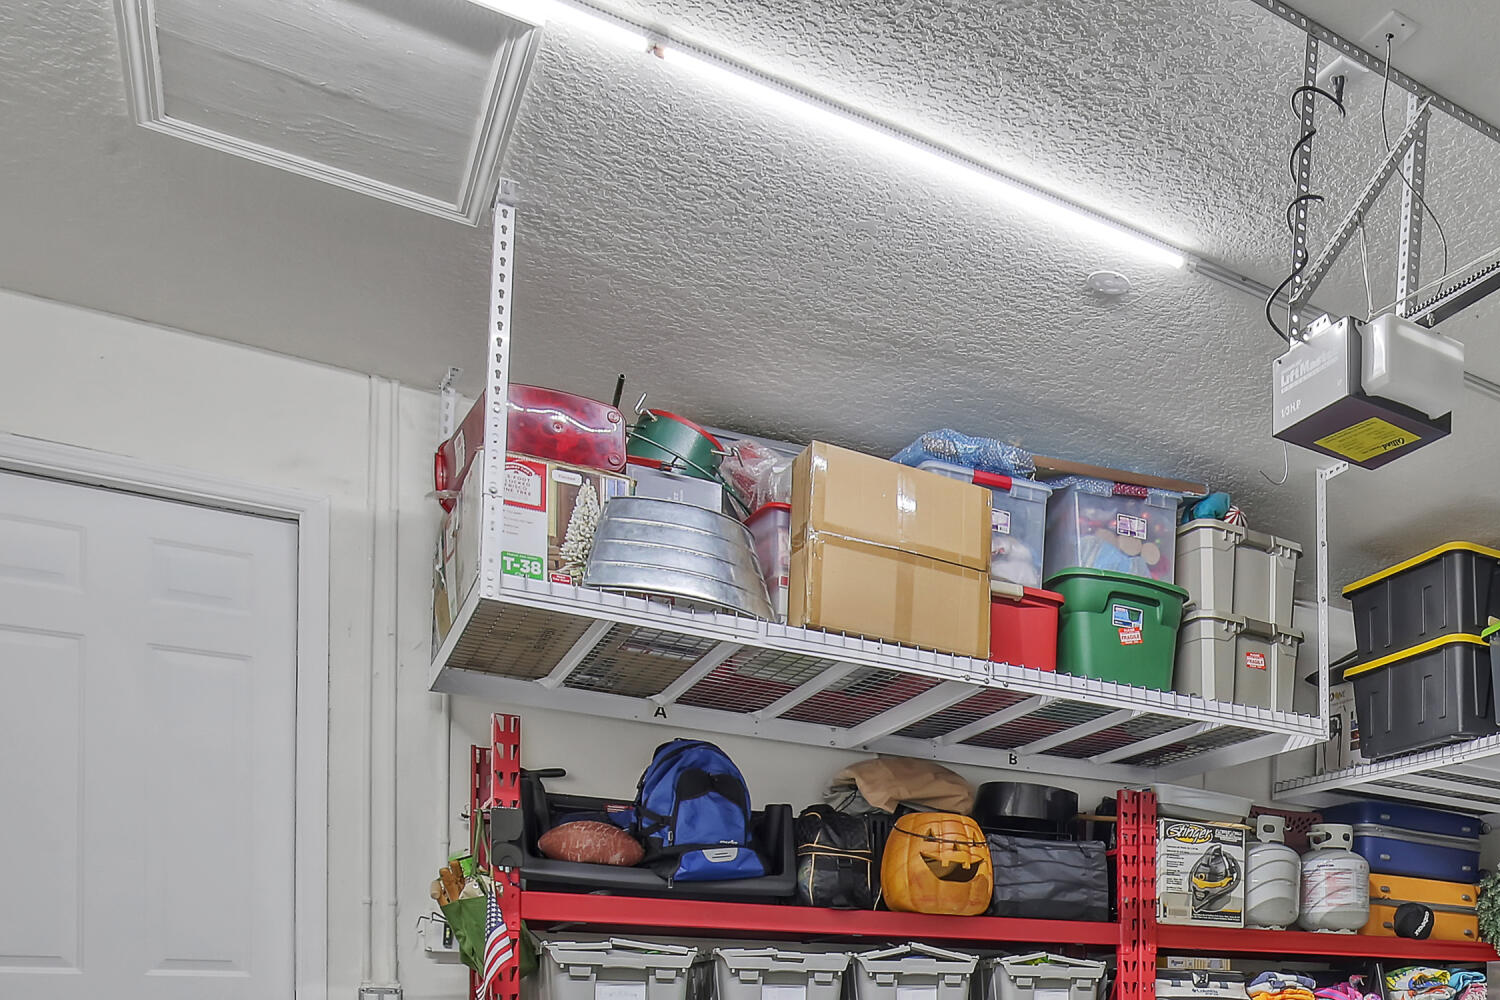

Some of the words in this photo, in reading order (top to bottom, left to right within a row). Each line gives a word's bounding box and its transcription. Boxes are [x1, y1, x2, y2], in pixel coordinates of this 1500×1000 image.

[503, 556, 542, 576] T-38
[653, 705, 668, 719] A
[1007, 753, 1019, 766] B
[1168, 824, 1213, 844] Stinger
